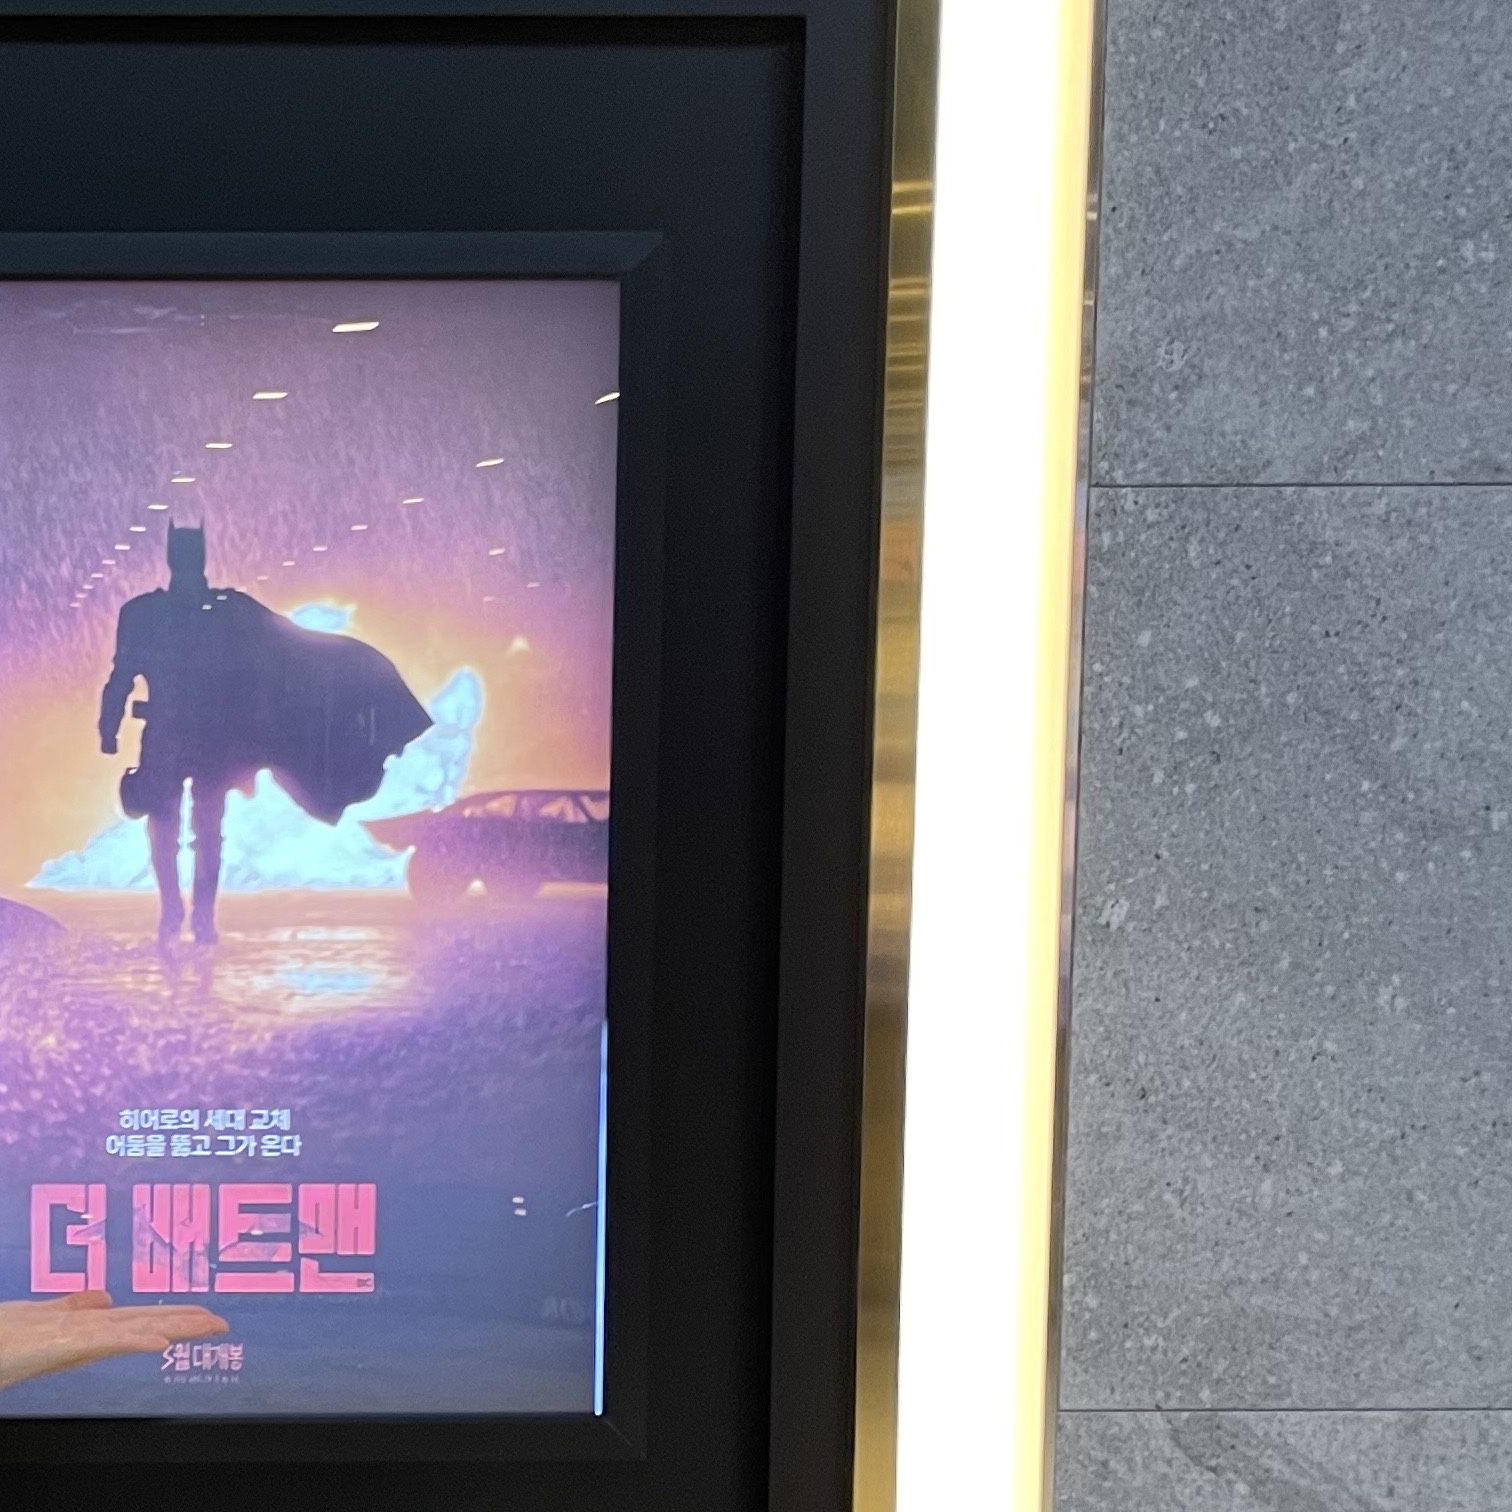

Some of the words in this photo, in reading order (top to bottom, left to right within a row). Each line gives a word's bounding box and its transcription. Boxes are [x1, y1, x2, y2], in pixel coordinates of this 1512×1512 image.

[119, 1109, 200, 1131] 히어로의
[203, 1109, 246, 1131] 세대
[248, 1109, 291, 1131] 교체
[105, 1134, 166, 1157] 어둠을
[170, 1134, 212, 1157] 뚫고
[215, 1134, 257, 1157] 그가
[260, 1134, 303, 1157] 온다
[30, 1183, 107, 1292] 더
[132, 1183, 377, 1292] 배트맨
